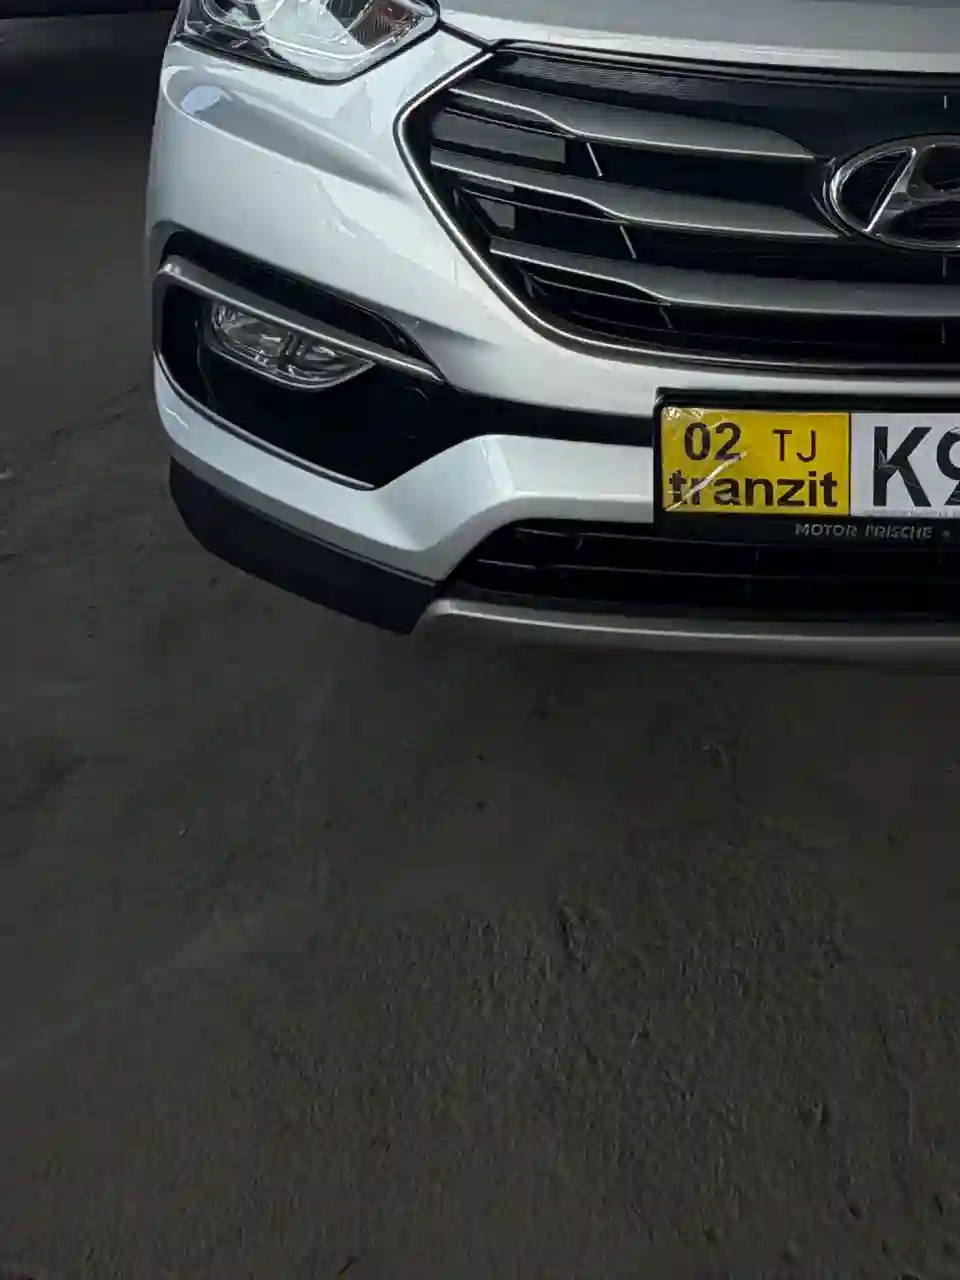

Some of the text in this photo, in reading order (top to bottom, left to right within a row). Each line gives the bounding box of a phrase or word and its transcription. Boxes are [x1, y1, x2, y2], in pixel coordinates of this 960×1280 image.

[683, 422, 817, 462] 02 TJ
[668, 468, 839, 509] tranzit
[794, 523, 858, 537] MOTOR
